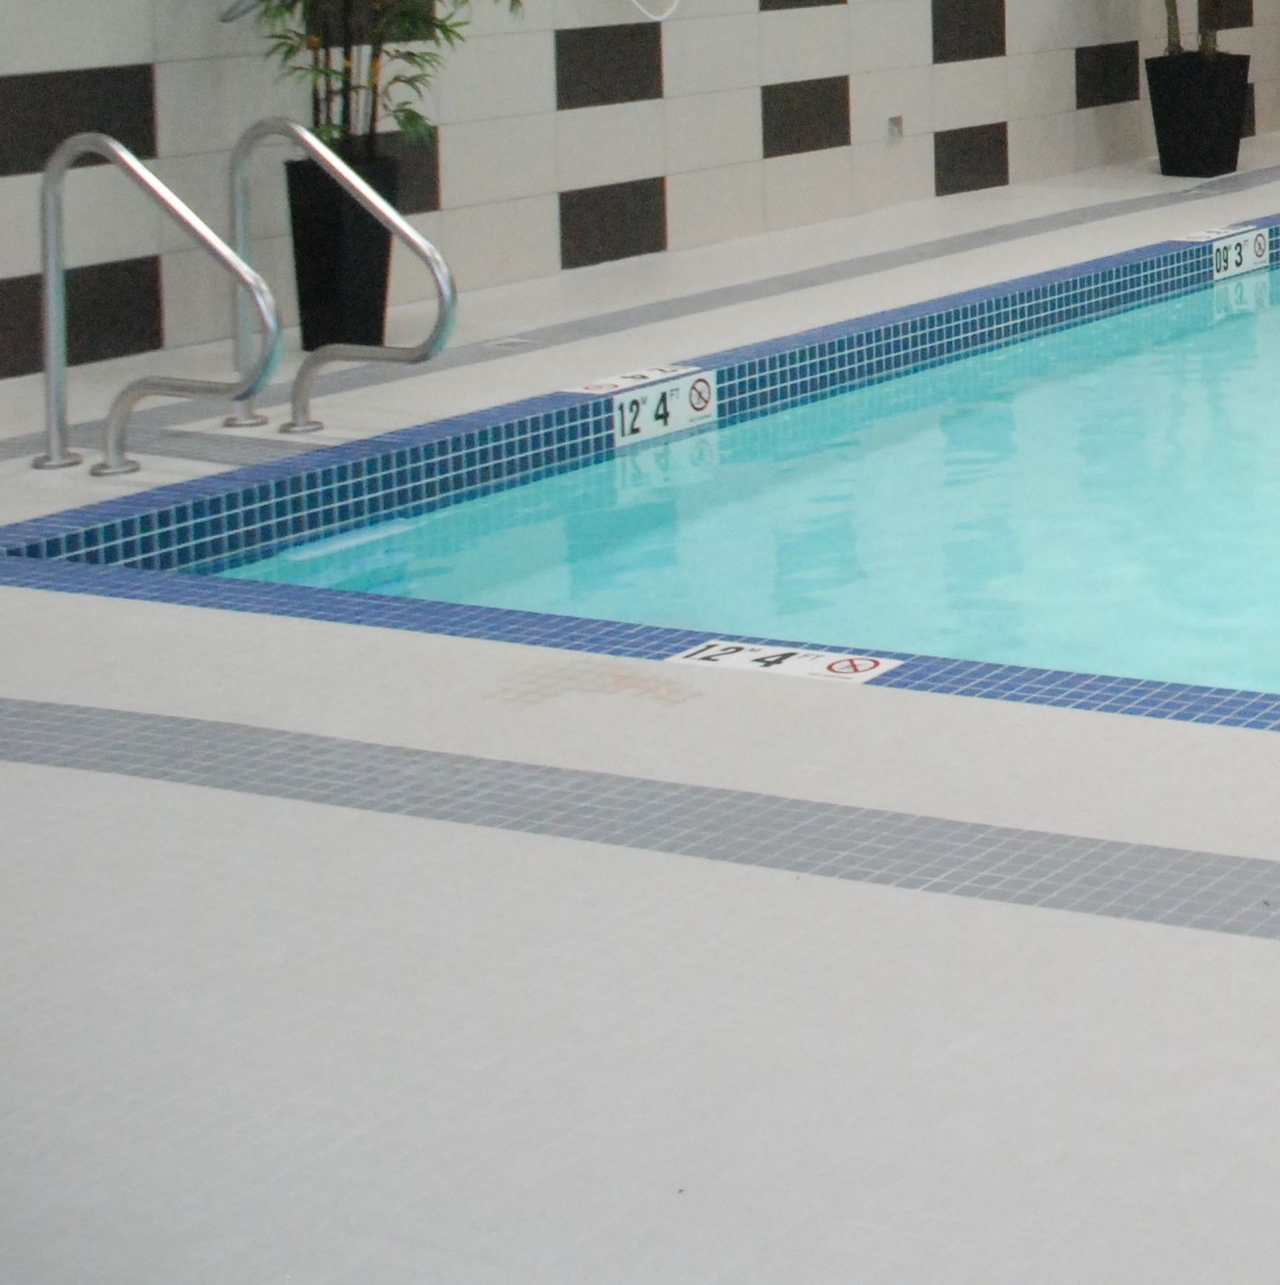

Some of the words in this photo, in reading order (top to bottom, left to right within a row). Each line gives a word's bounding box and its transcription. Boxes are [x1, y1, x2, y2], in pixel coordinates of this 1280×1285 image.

[1234, 242, 1243, 267] 3
[654, 392, 670, 426] 4
[751, 651, 798, 667] 4
